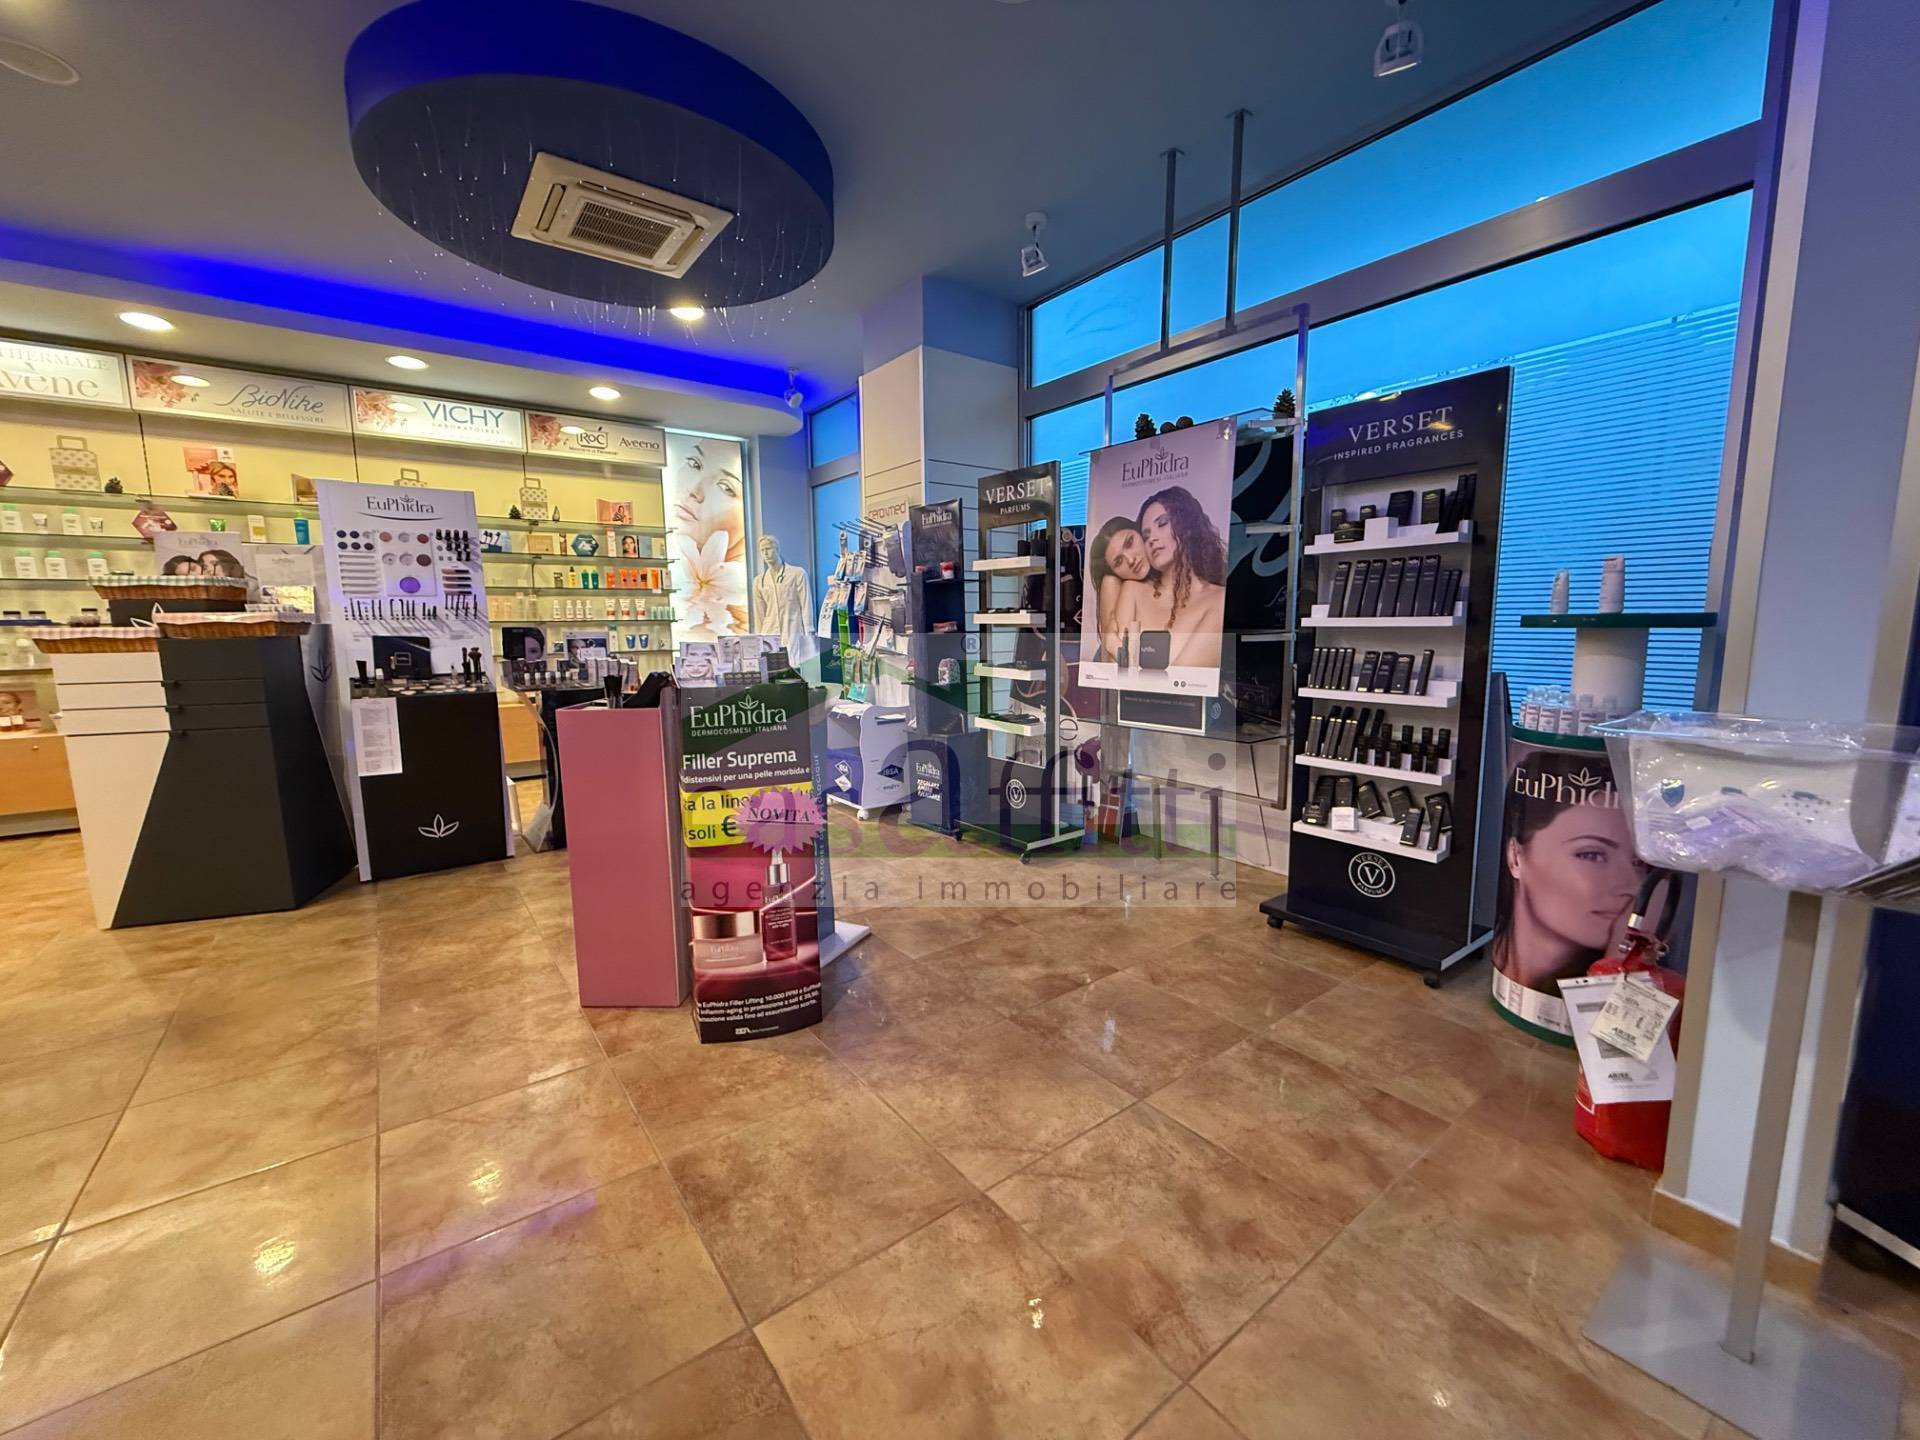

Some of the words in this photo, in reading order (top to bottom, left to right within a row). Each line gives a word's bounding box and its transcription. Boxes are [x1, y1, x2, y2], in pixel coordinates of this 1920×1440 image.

[213, 383, 324, 413] BioNike
[423, 401, 504, 428] VICHY
[1349, 406, 1453, 443] VERSET
[619, 437, 660, 450] Aveeno
[1333, 445, 1382, 461] INSPIRED
[1386, 429, 1464, 450] FRAGRANCES
[1121, 453, 1189, 482] EuPhidra
[986, 476, 1050, 505] VERSET
[366, 495, 435, 514] EuPhidra
[1000, 502, 1031, 516] PARFUMS
[690, 701, 787, 729] EuPhidra
[691, 727, 751, 737] DERMOCOSMESI
[755, 724, 788, 733] ITALIANA
[682, 753, 723, 770] Filler
[726, 749, 797, 770] Suprema
[723, 773, 737, 783] per
[738, 772, 753, 780] una
[754, 769, 773, 780] pelle
[774, 766, 805, 777] morbida
[702, 796, 716, 810] la
[688, 825, 716, 840] soli
[721, 815, 737, 838] €
[1354, 852, 1389, 870] VERSET
[1357, 882, 1386, 896] PARFUMS
[745, 997, 764, 1005] Lifting
